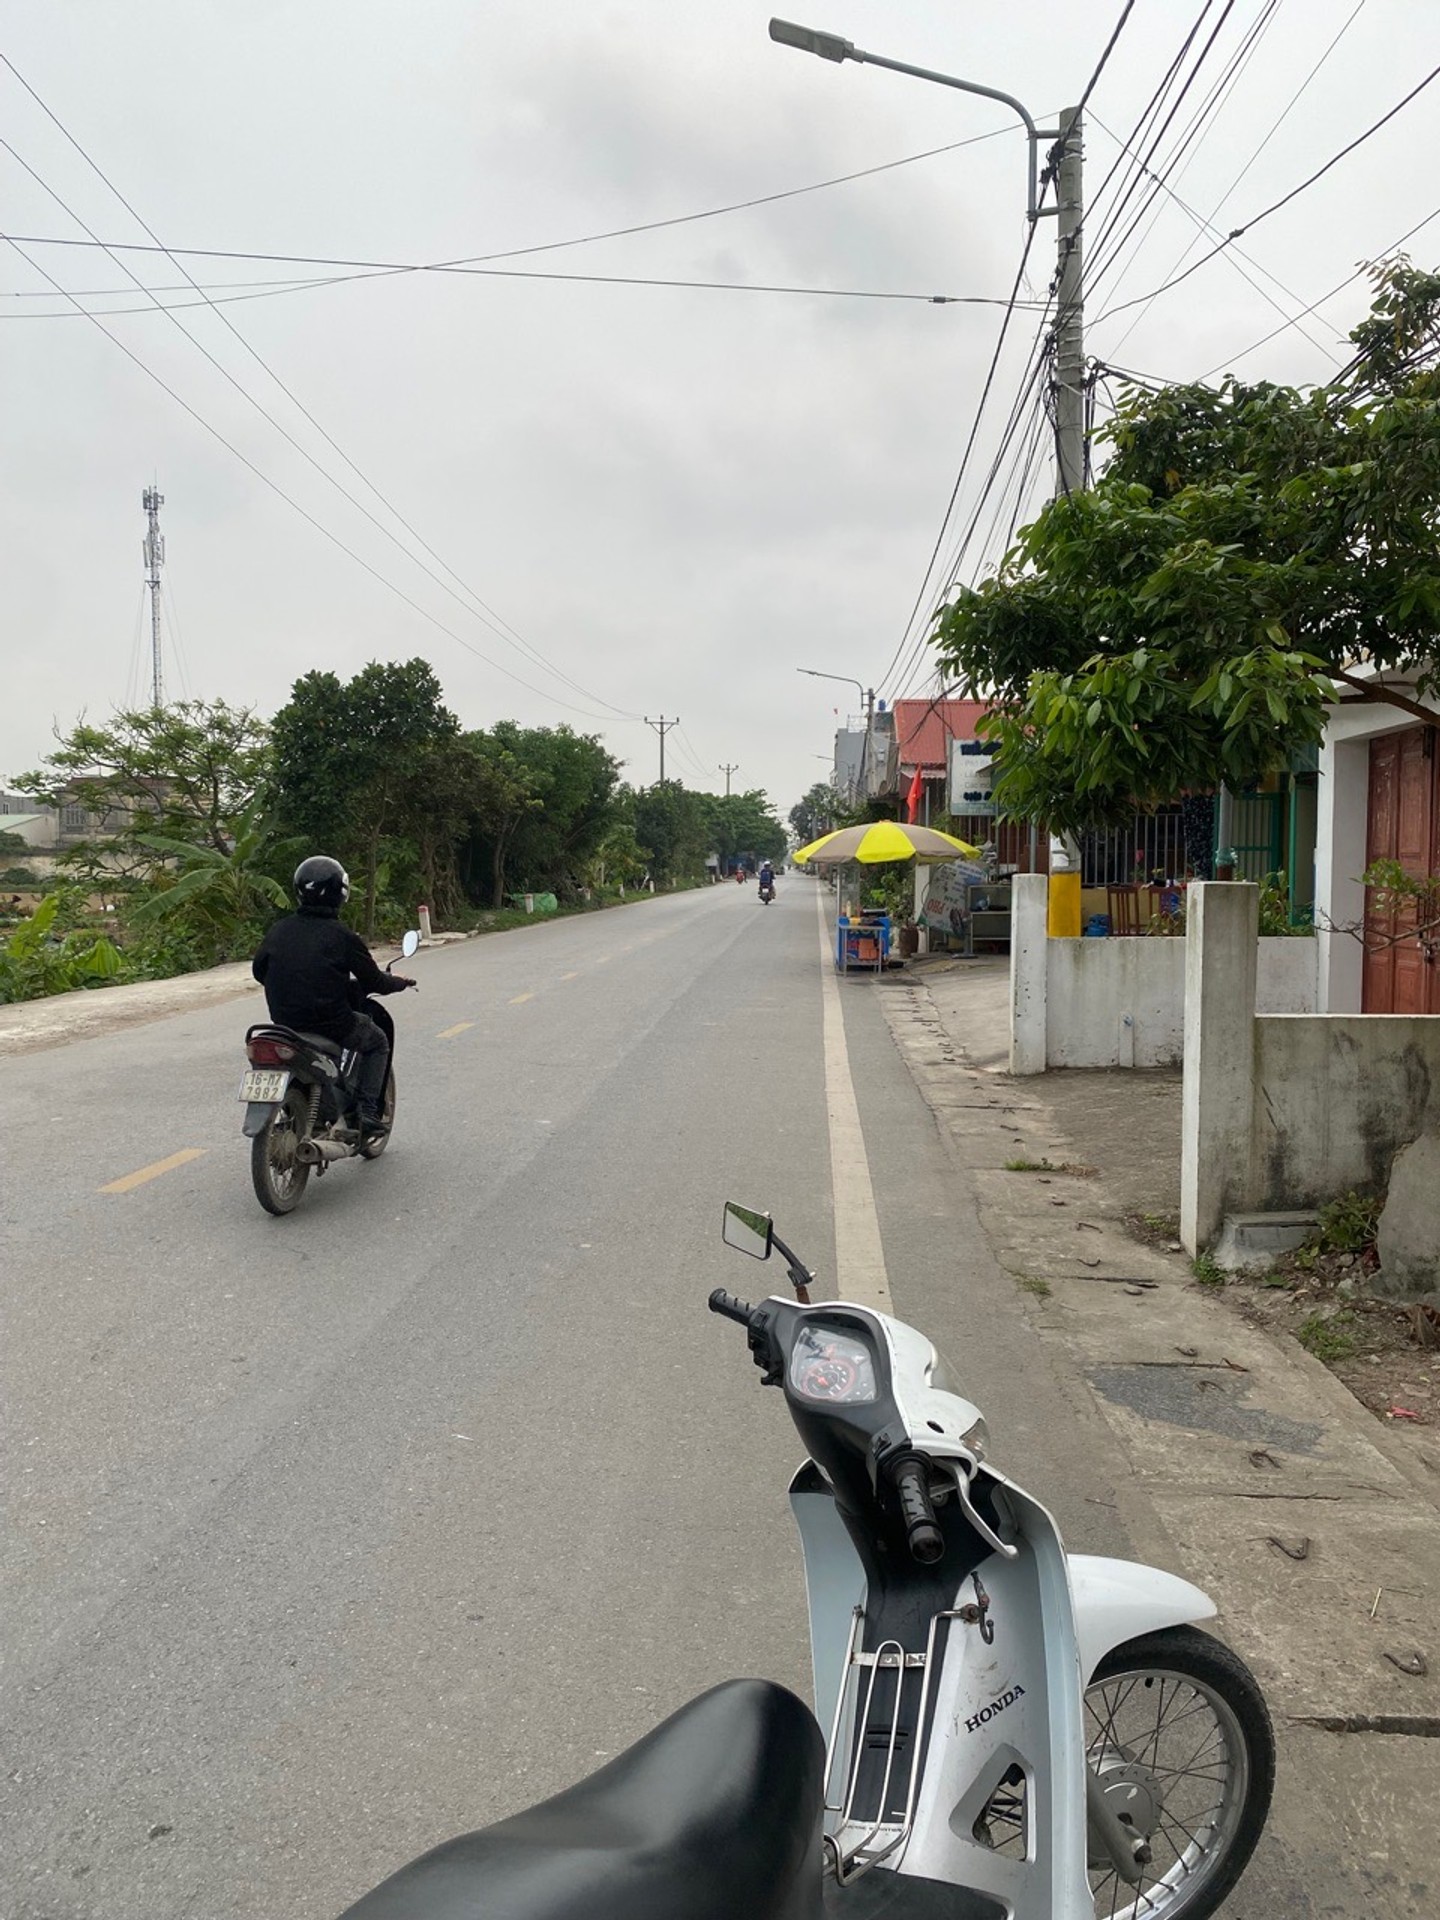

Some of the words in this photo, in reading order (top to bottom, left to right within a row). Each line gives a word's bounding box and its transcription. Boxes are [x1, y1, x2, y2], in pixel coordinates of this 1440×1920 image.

[250, 1072, 283, 1086] 16-M7
[246, 1086, 279, 1100] 7982
[964, 1684, 1026, 1734] HONDA
